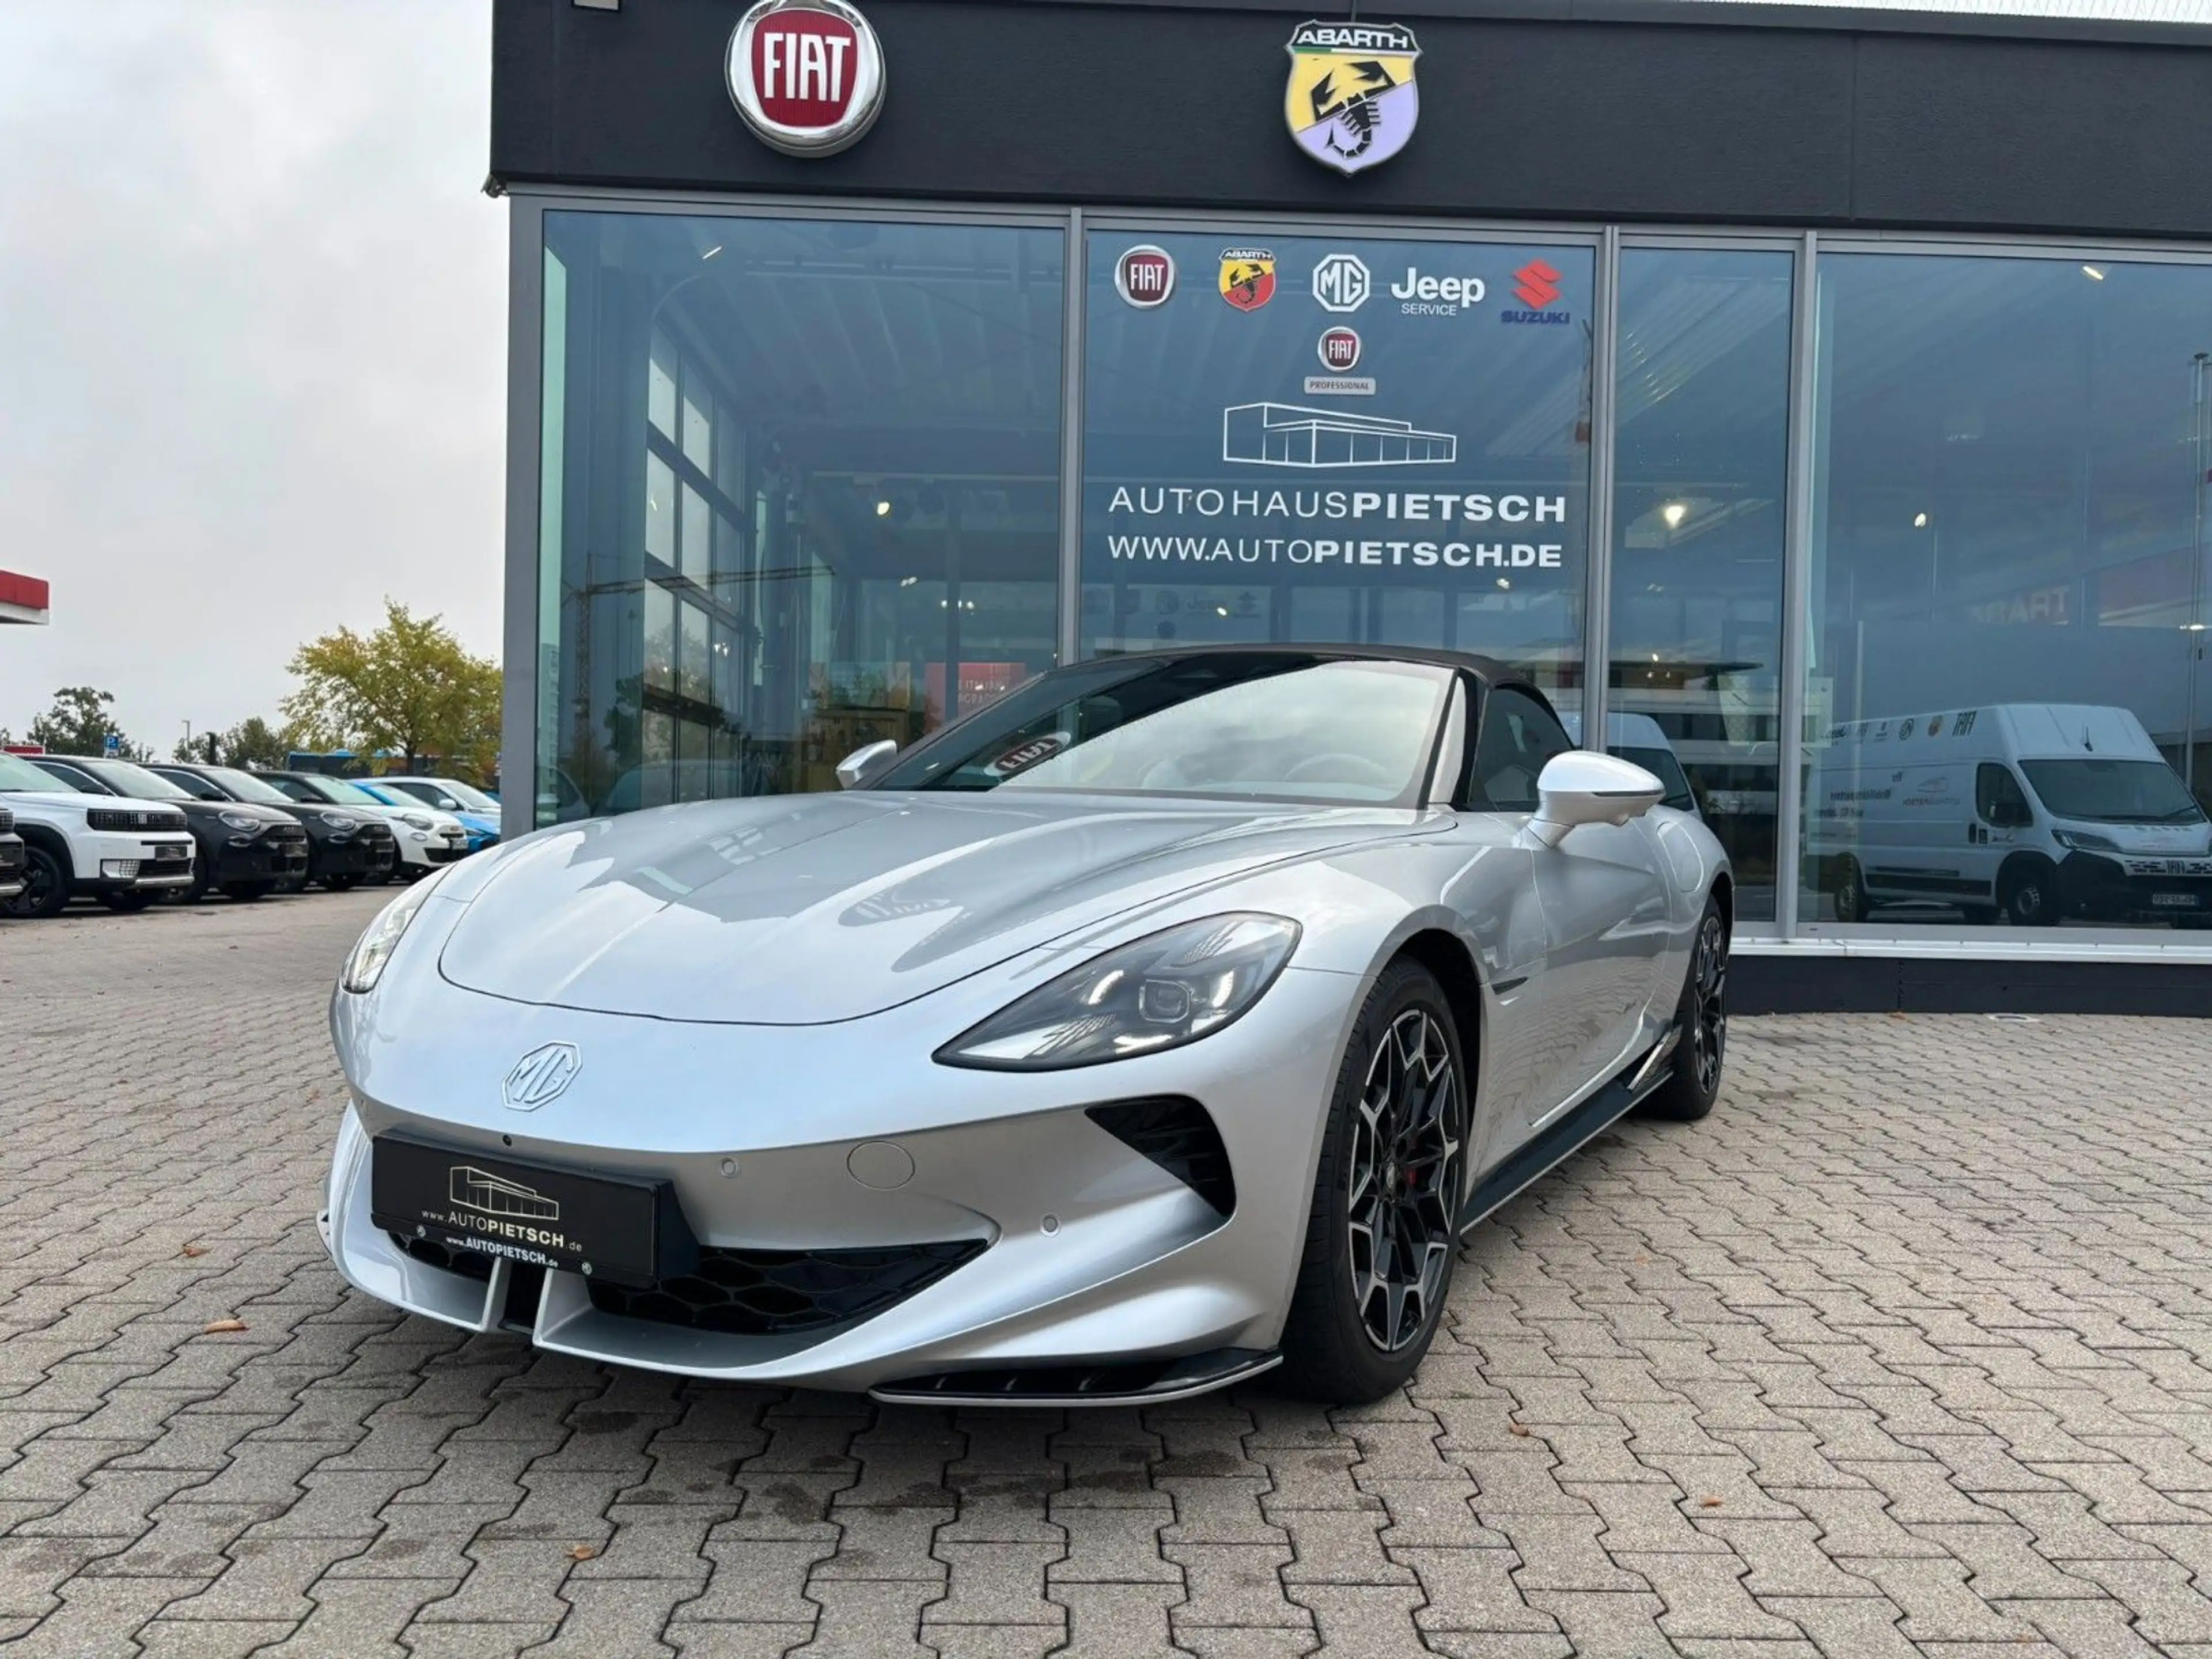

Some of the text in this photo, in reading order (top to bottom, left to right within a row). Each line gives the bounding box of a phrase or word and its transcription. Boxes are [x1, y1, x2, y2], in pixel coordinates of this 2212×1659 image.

[1297, 29, 1408, 48] ABARTH
[764, 32, 851, 103] FIAT
[1223, 249, 1273, 260] ABARTH
[1130, 262, 1164, 292] FIAT
[1319, 262, 1365, 305] MG
[1391, 267, 1485, 308] Jeep
[1402, 302, 1457, 316] SERVICE
[1501, 310, 1570, 325] SUZUKI
[1328, 339, 1353, 360] FIAT
[1310, 381, 1369, 391] PROFESSIONAL
[1108, 535, 1562, 568] WWW.AUTOPIETSCH.DE
[509, 1047, 575, 1104] MG
